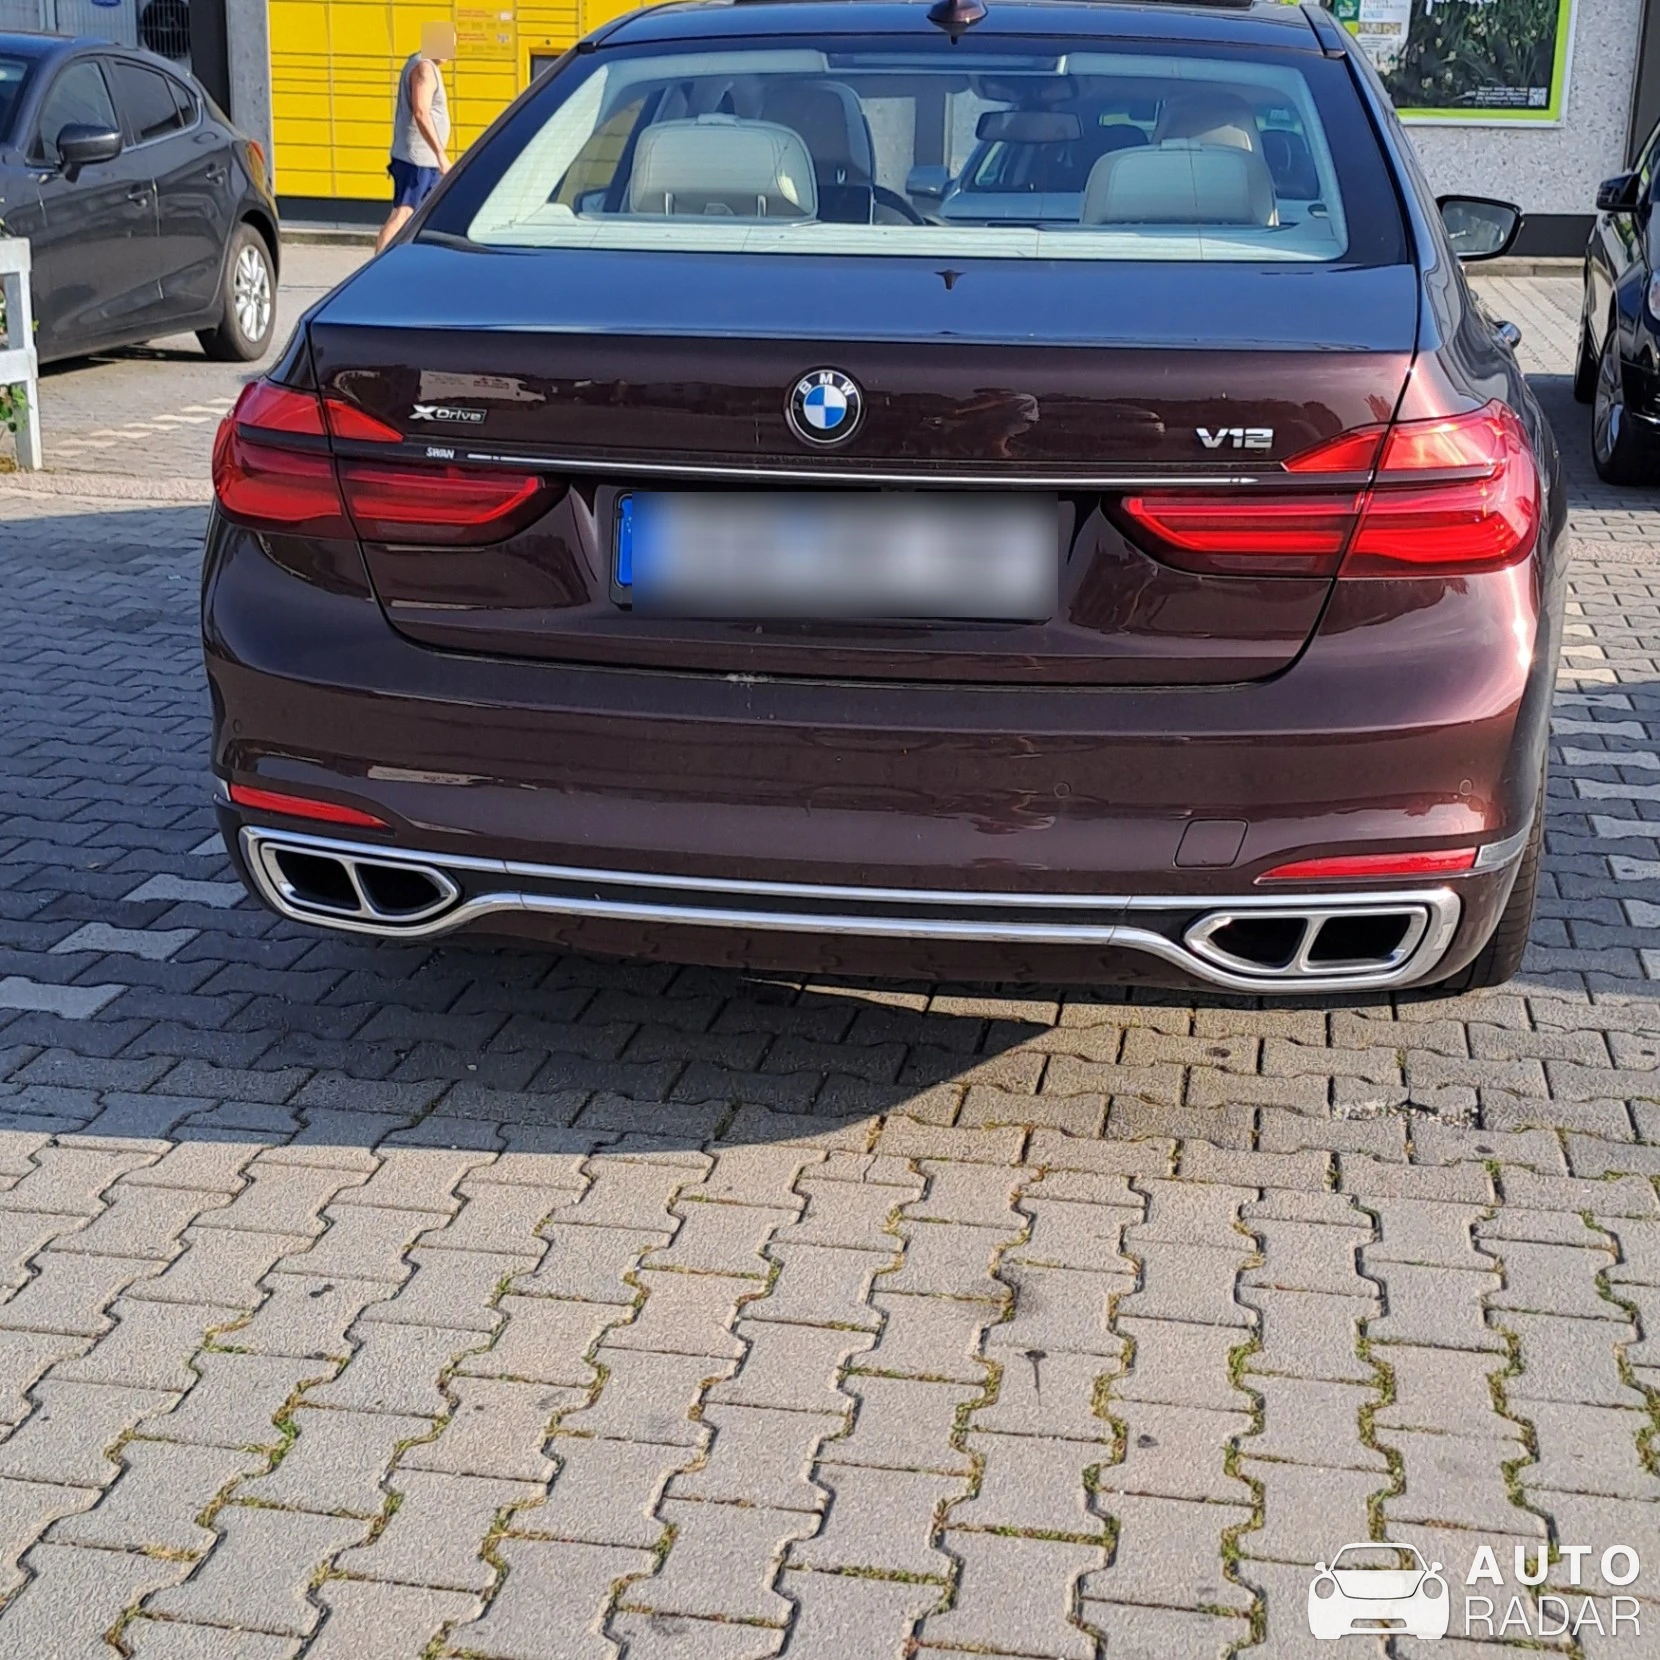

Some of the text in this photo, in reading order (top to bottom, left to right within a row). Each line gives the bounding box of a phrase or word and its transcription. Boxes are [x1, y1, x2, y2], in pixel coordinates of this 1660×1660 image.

[799, 373, 855, 396] BMW
[1196, 428, 1273, 448] V12
[426, 447, 454, 459] SWAN
